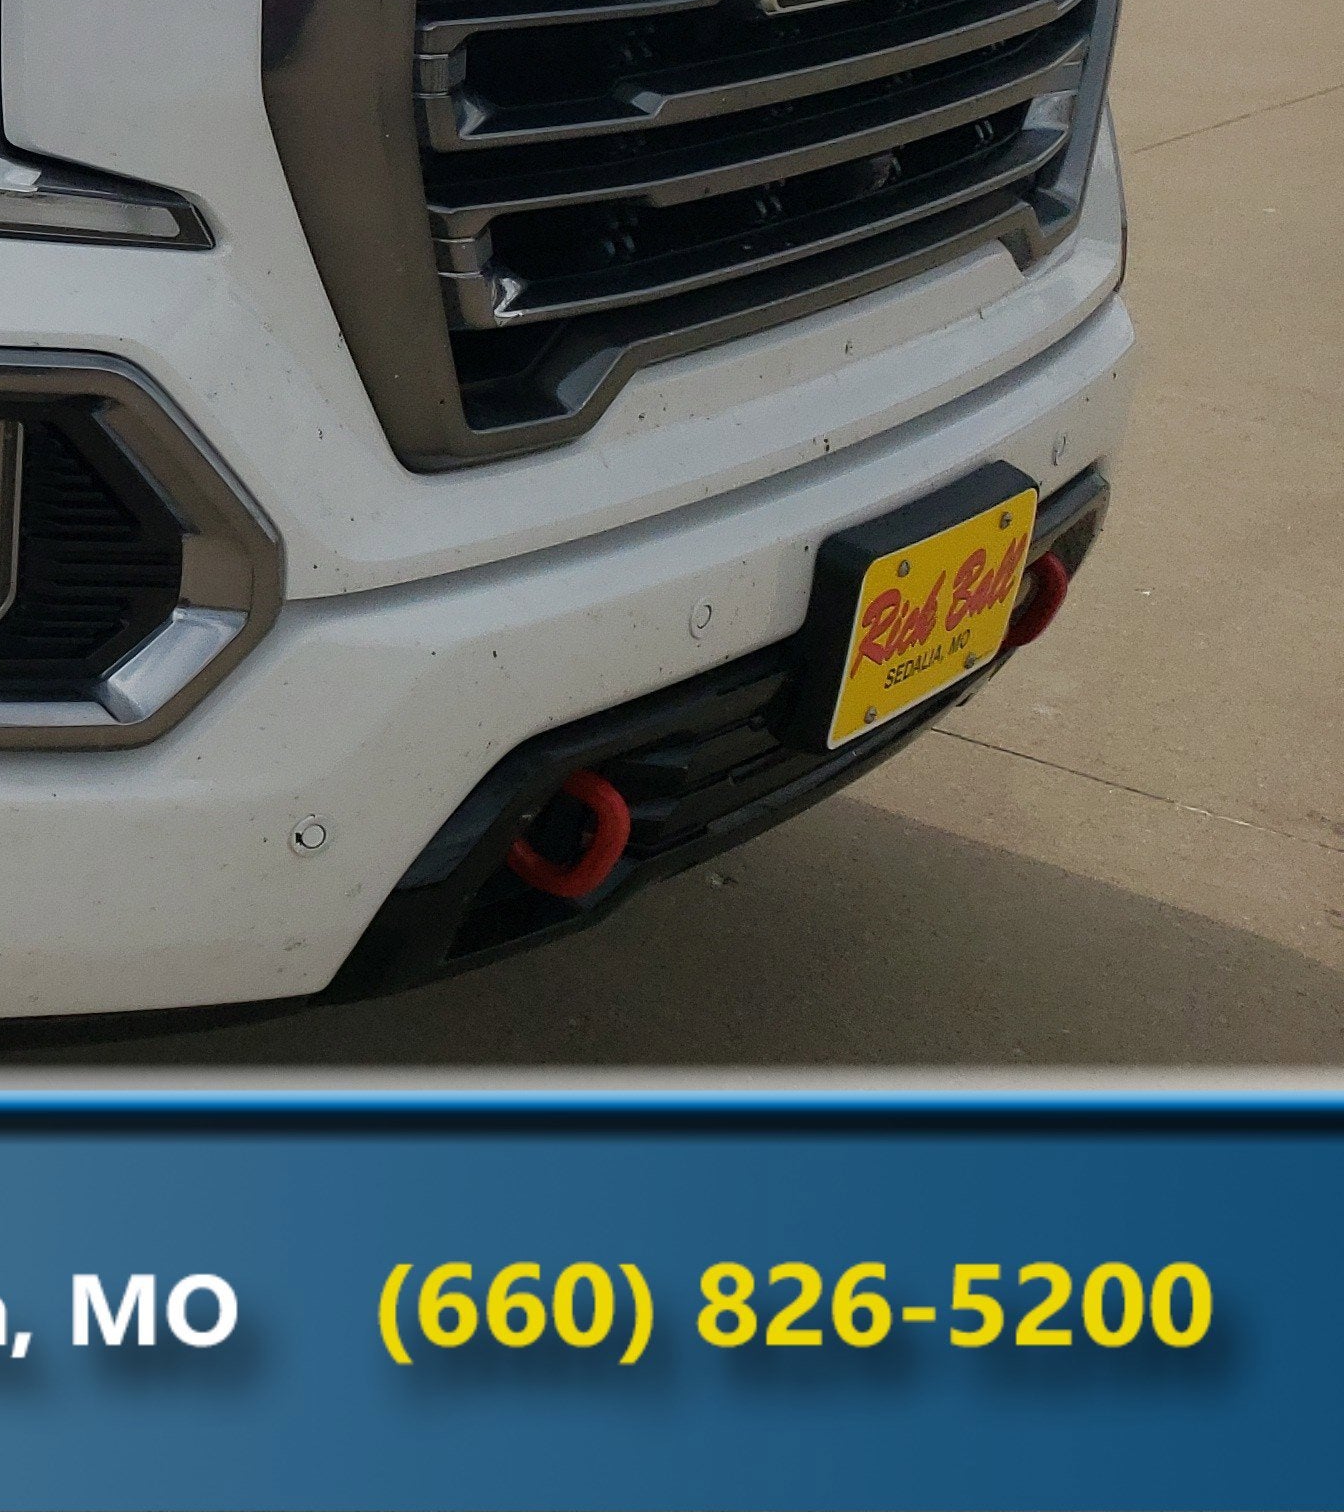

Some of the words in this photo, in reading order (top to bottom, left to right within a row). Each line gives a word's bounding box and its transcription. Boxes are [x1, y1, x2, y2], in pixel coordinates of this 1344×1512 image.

[850, 568, 947, 680] Rick
[944, 532, 1029, 633] Ball
[882, 642, 946, 690] SEDALIA,
[948, 628, 973, 658] MO
